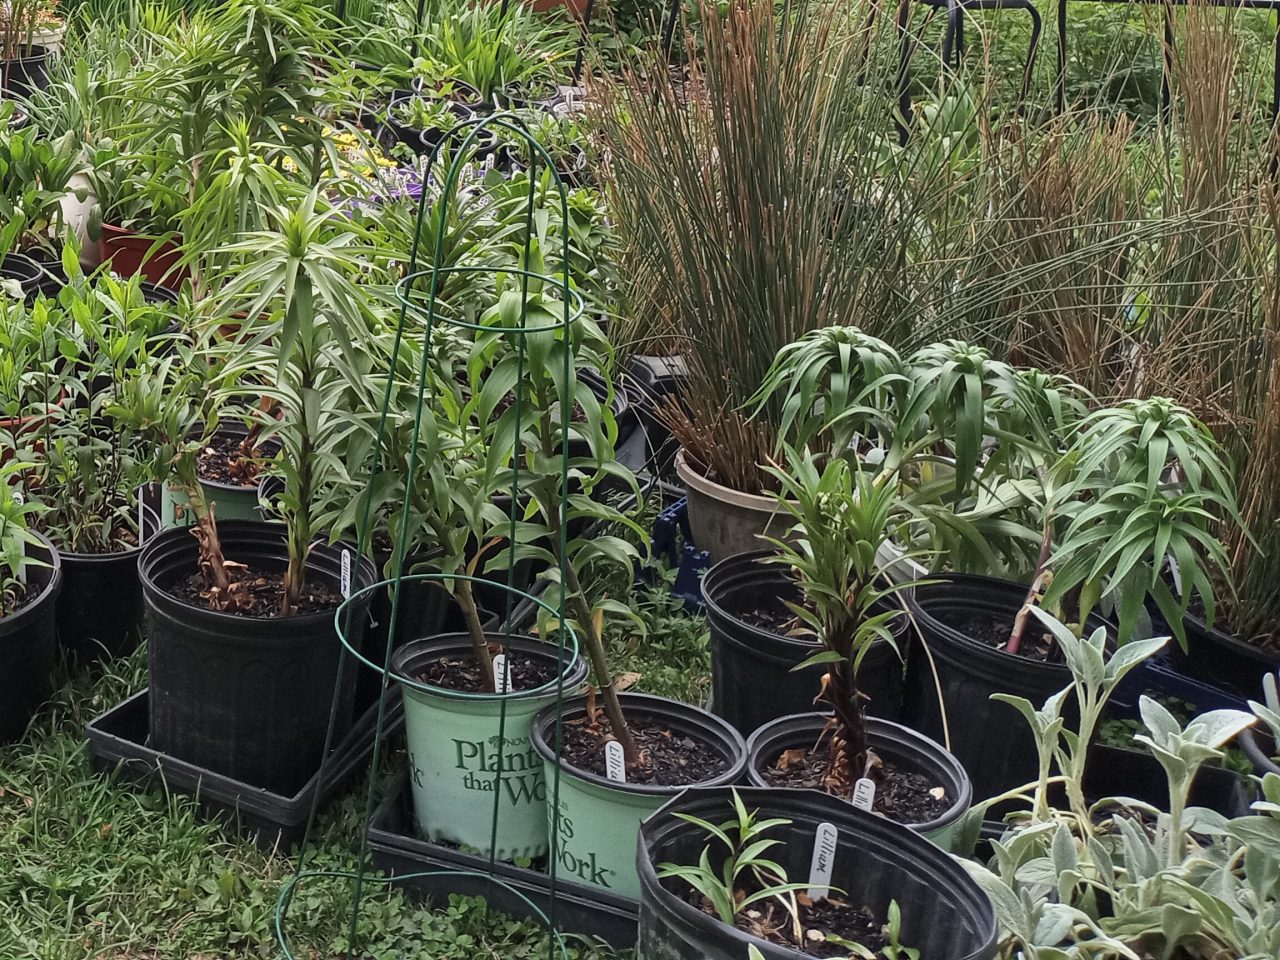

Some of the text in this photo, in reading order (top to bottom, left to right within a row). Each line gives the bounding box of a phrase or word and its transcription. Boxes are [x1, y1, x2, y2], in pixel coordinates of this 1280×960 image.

[609, 746, 622, 779] Lilliu
[500, 772, 546, 806] Wo
[816, 829, 835, 873] Lillium
